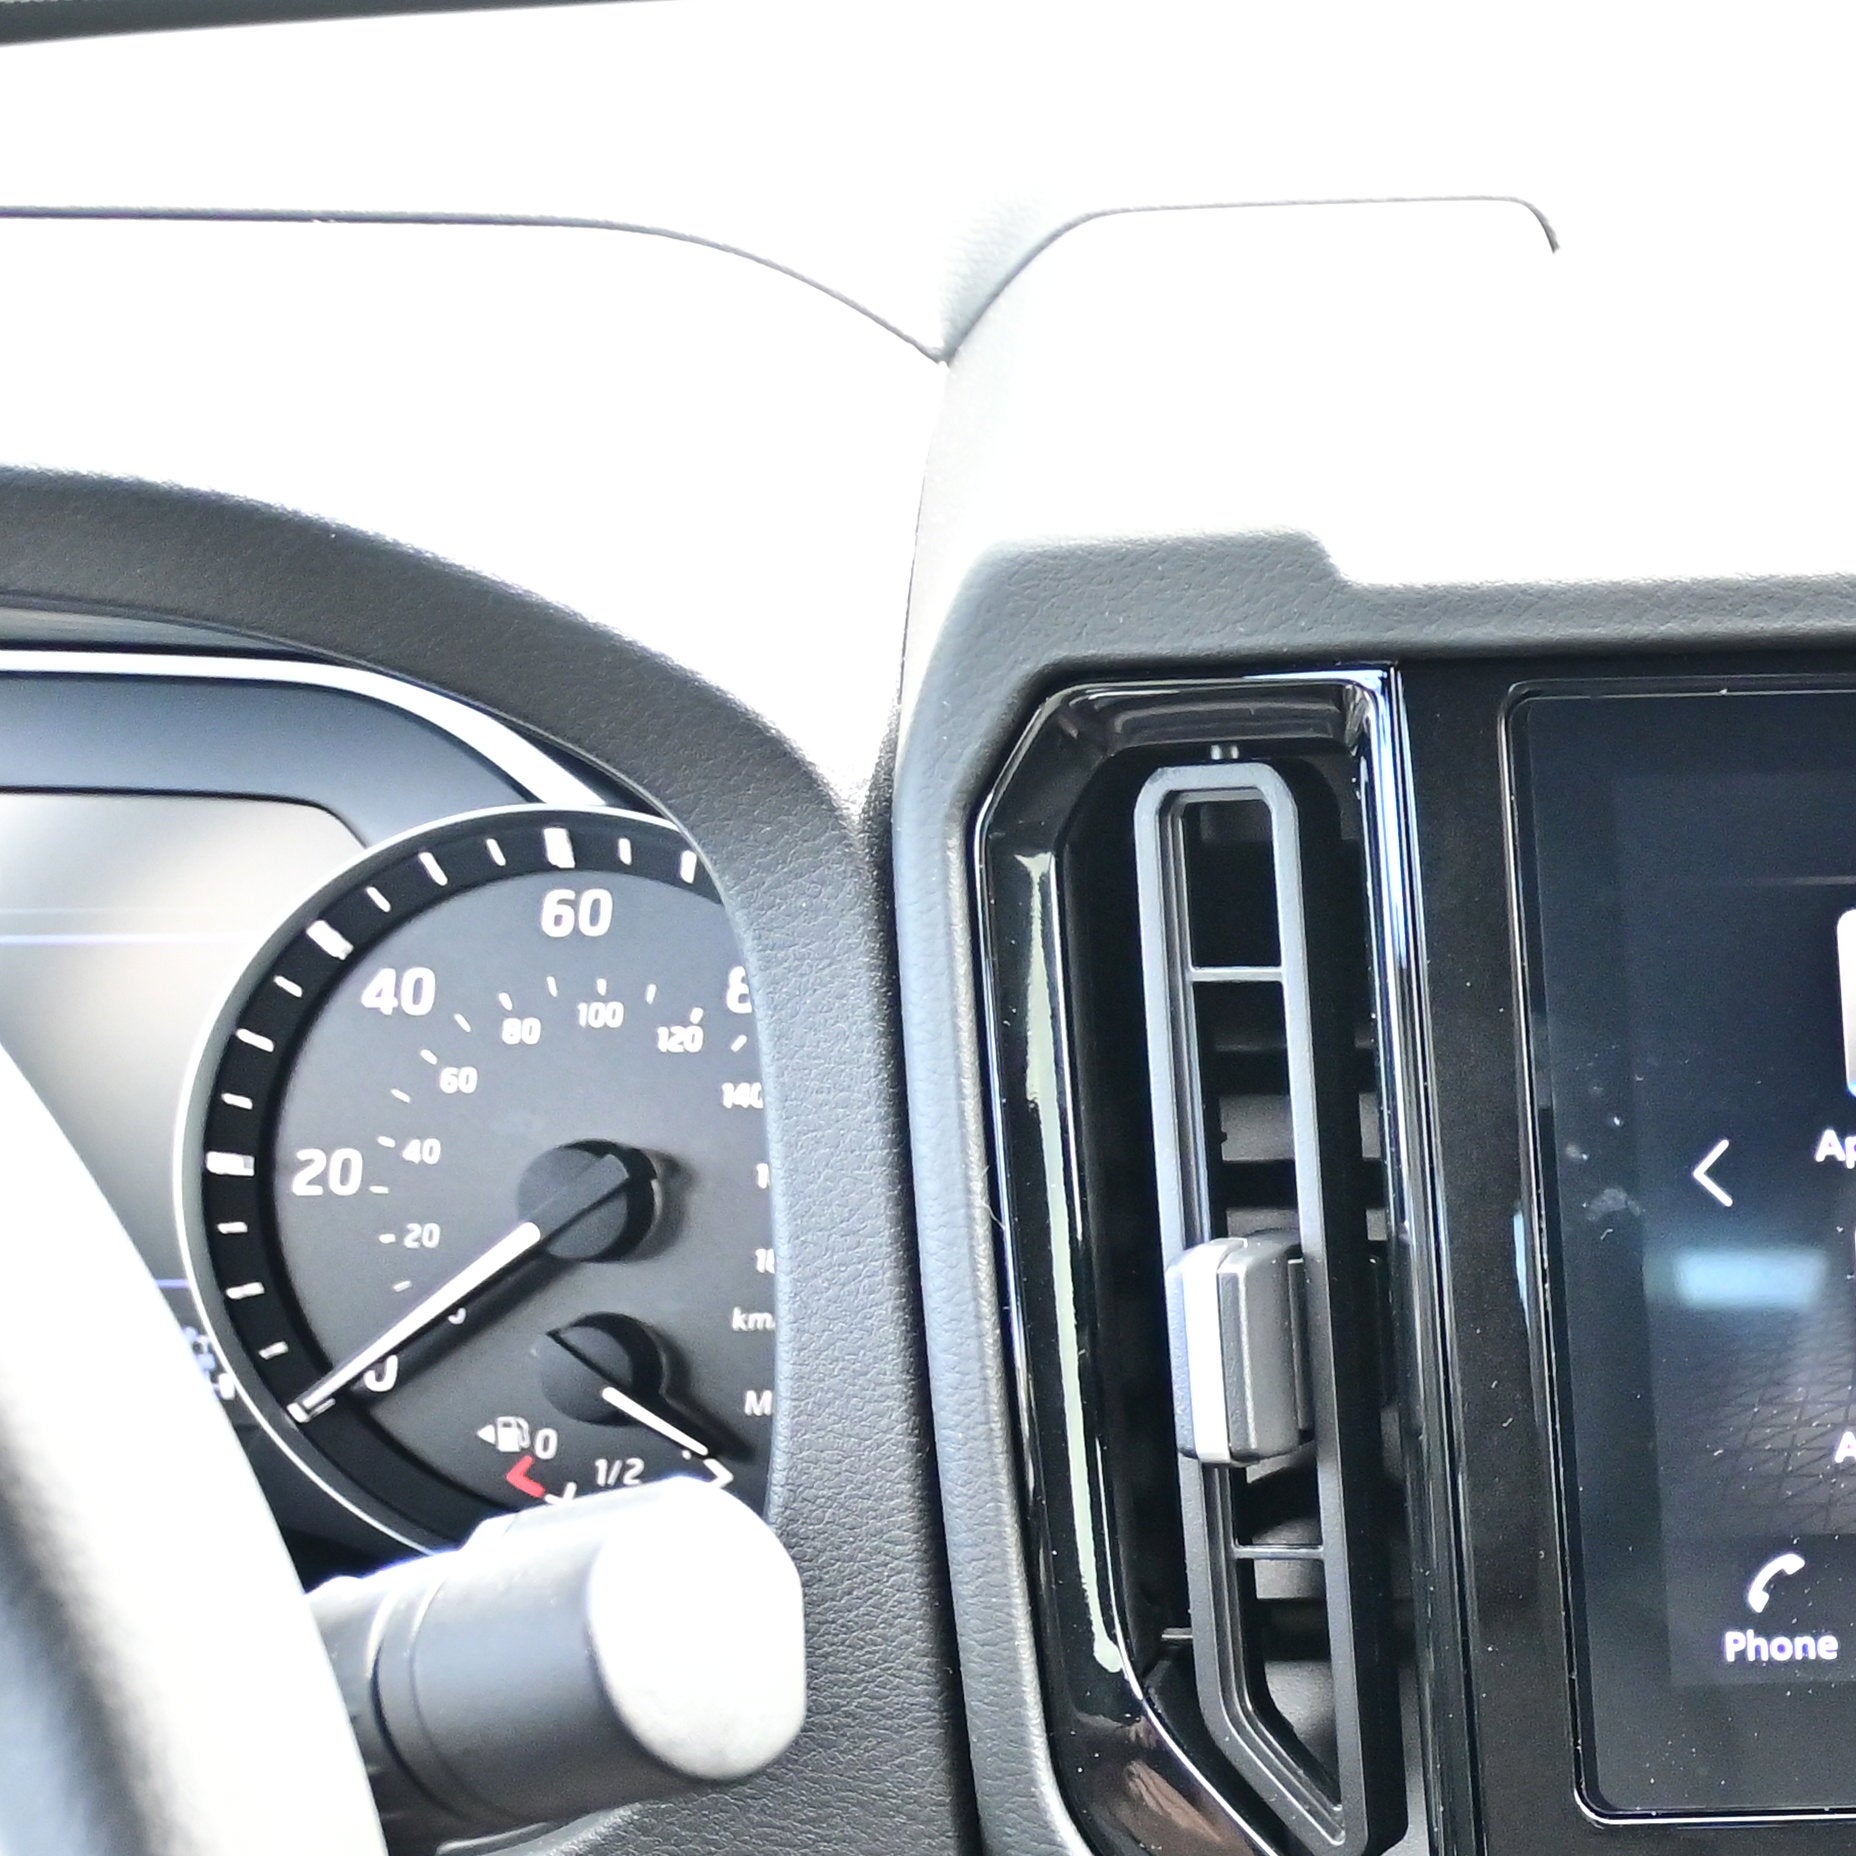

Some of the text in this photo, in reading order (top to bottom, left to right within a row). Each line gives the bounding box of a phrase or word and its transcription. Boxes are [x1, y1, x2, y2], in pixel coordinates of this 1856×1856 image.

[541, 888, 613, 937] 60
[361, 966, 435, 1016] 40
[727, 965, 753, 1015] 8
[578, 1001, 624, 1028] 100
[501, 1017, 541, 1046] 80
[657, 1025, 703, 1052] 120
[440, 1065, 477, 1093] 60
[402, 1139, 441, 1165] 40
[292, 1148, 363, 1196] 20
[403, 1224, 440, 1249] 20
[595, 1458, 644, 1487] 1/2
[1723, 1630, 1839, 1663] Phone
